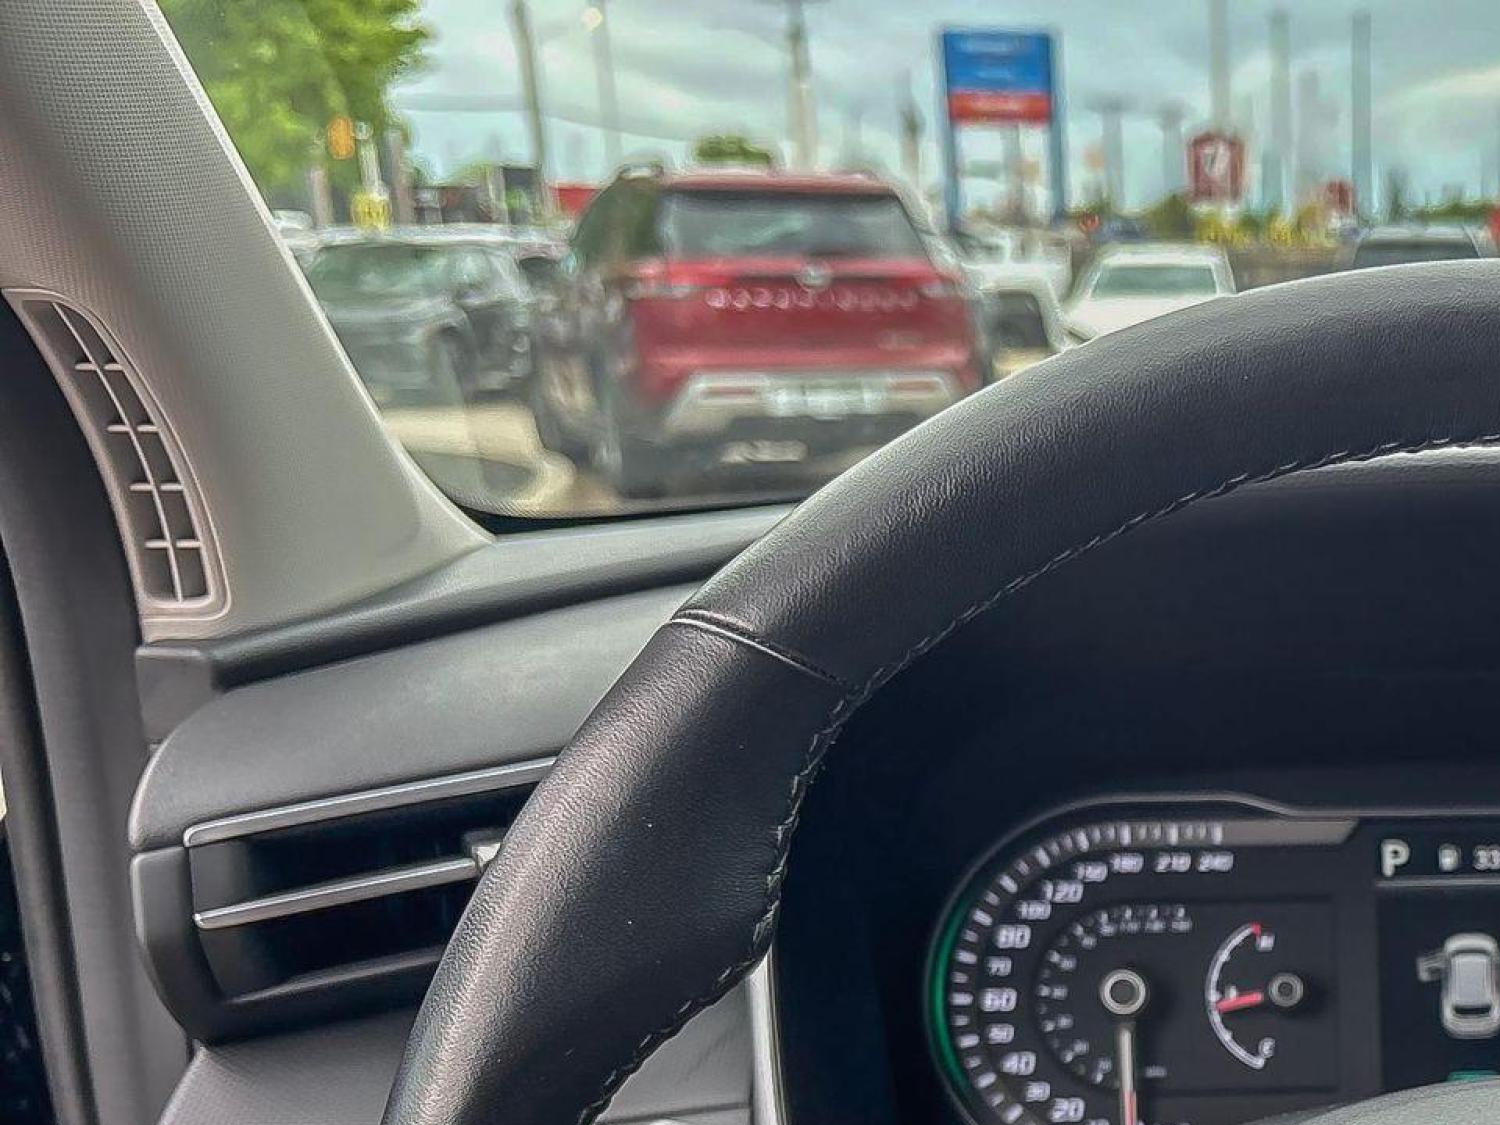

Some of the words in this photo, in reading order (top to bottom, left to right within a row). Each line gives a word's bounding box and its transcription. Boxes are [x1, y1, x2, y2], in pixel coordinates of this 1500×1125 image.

[1380, 838, 1410, 878] P
[1042, 879, 1084, 903] 120
[996, 924, 1031, 949] 80
[980, 987, 1018, 1012] 60
[1002, 1051, 1037, 1076] 40
[1049, 1097, 1086, 1123] 20
